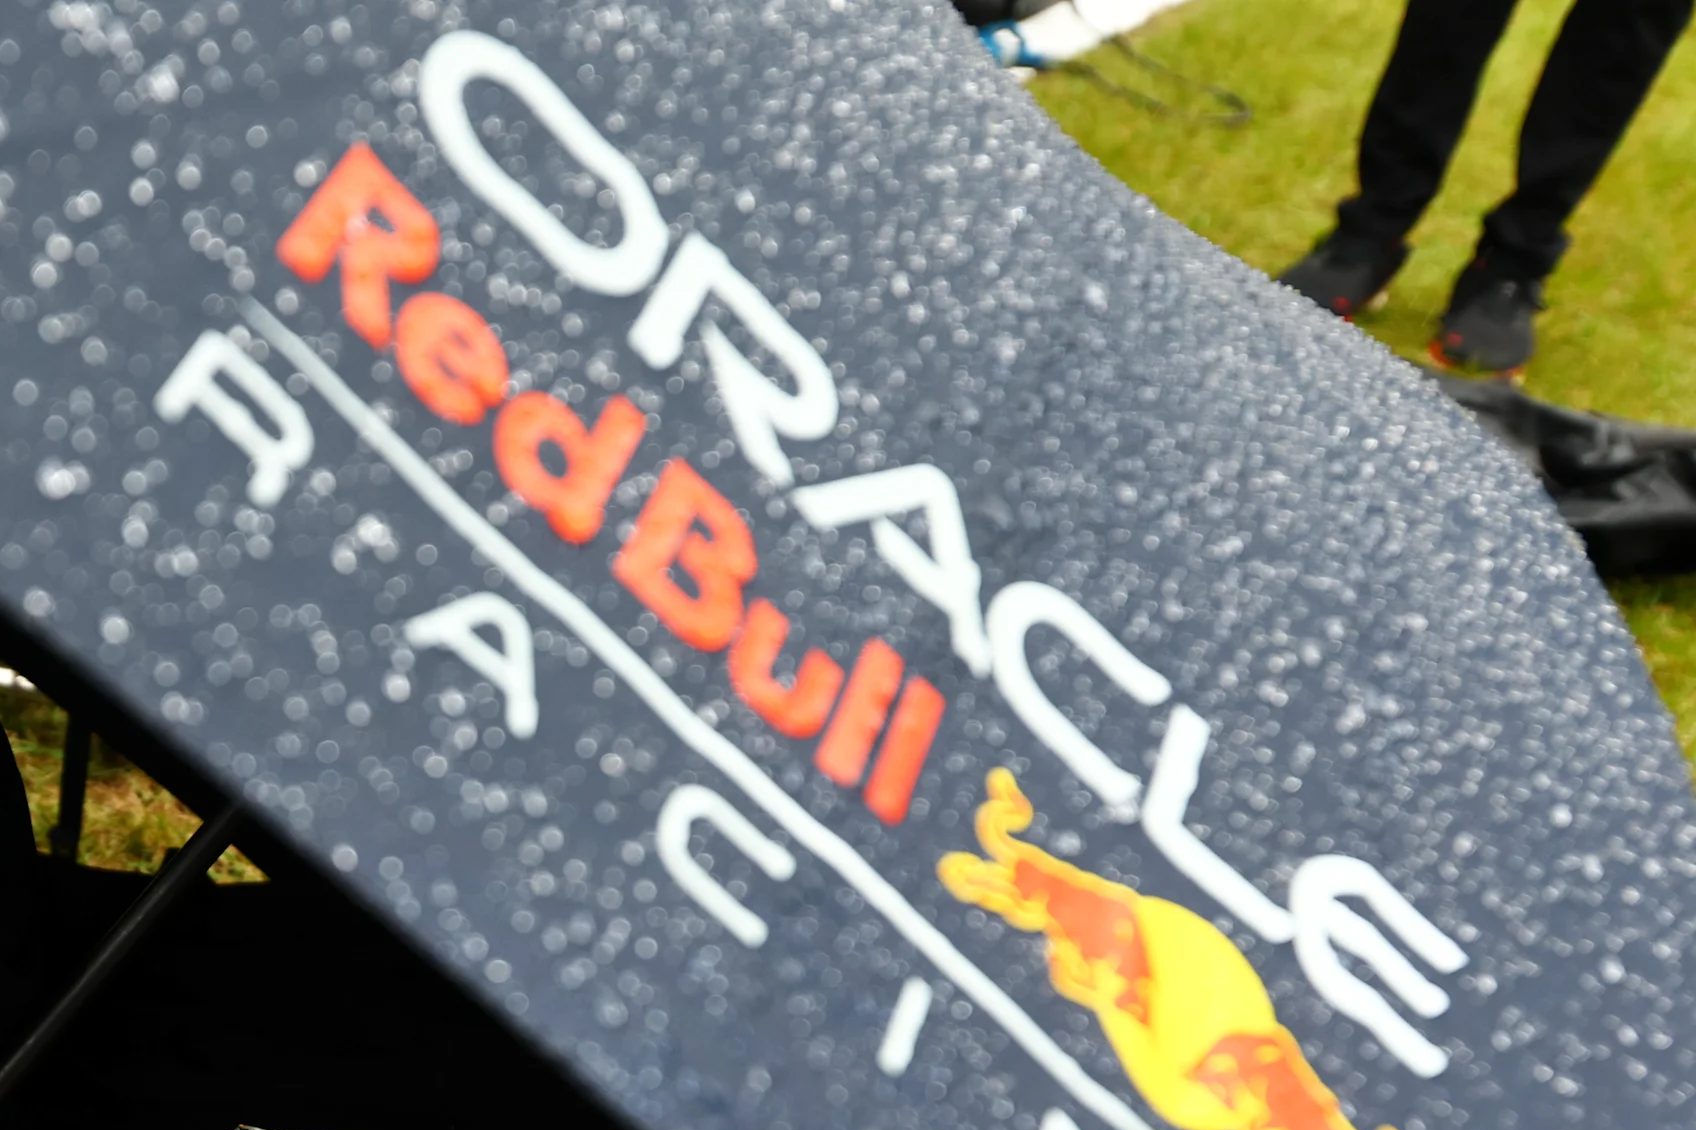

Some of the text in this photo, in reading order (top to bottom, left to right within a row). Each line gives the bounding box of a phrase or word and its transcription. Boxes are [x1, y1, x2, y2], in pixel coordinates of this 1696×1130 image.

[276, 139, 947, 826] Red Bull
[416, 28, 1470, 1078] ORACLE
